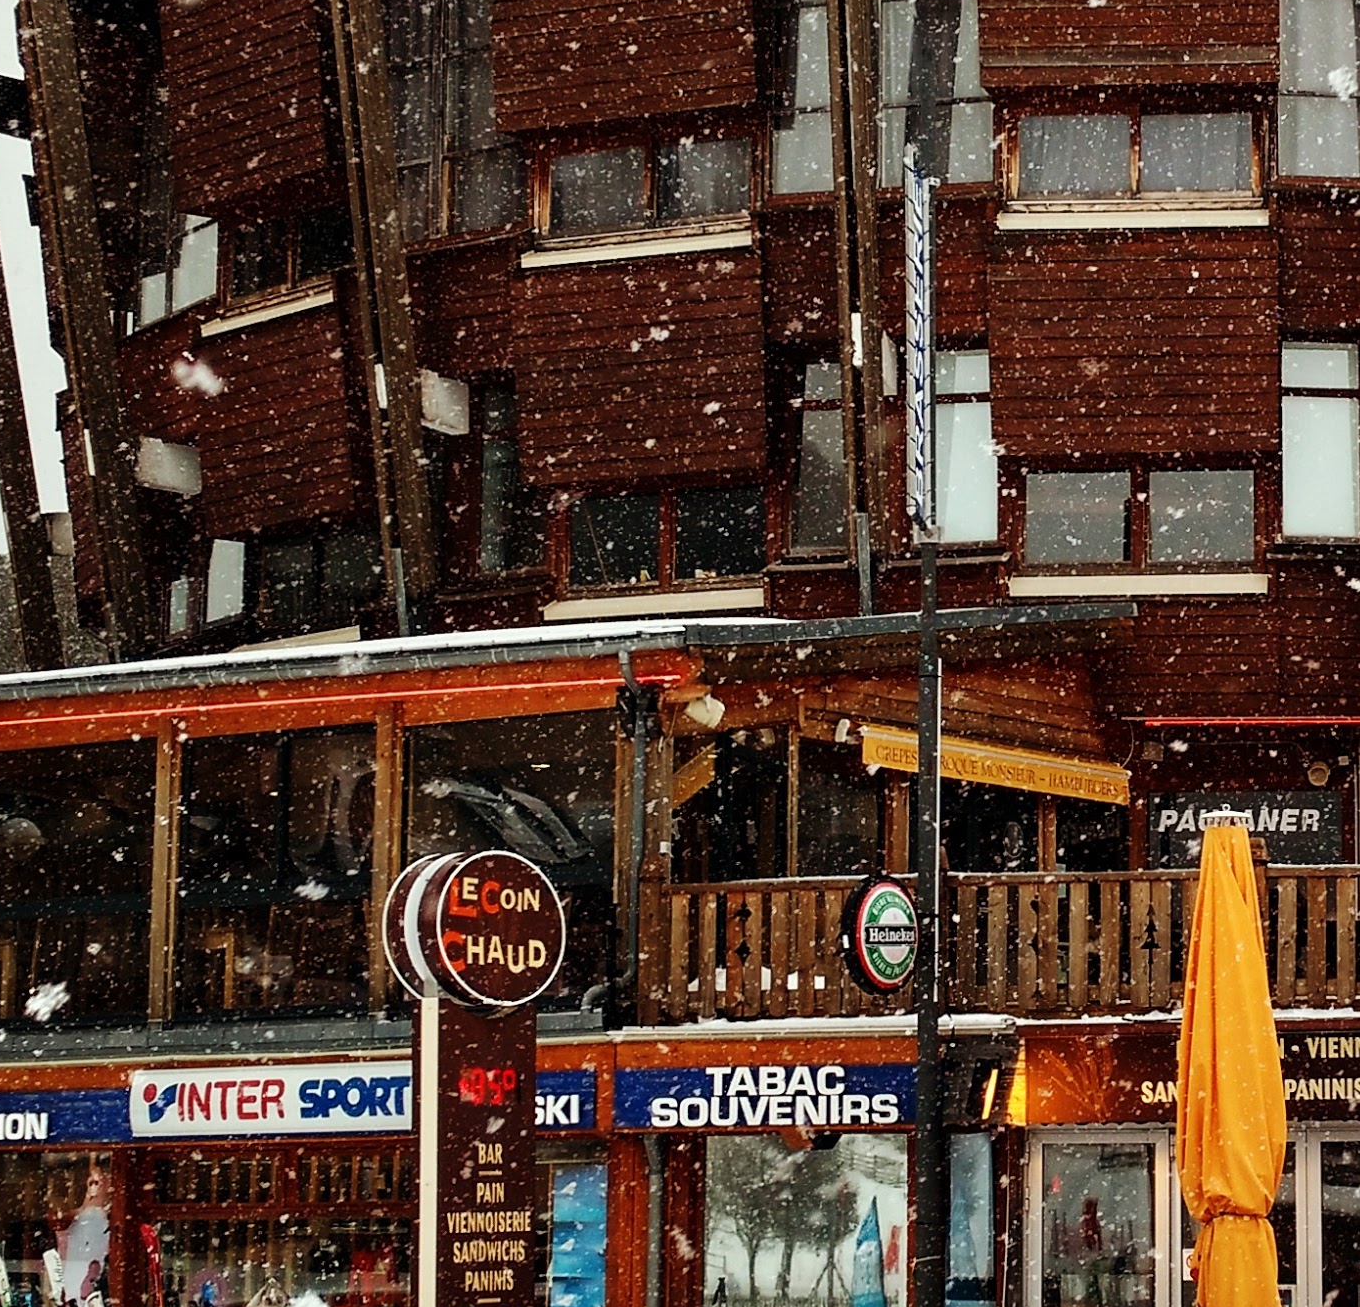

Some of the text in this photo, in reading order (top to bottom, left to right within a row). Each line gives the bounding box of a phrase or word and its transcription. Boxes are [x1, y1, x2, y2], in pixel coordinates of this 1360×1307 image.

[941, 755, 977, 775] ROQUE
[869, 927, 915, 942] Heineken
[439, 930, 547, 974] CHAUD
[705, 1066, 846, 1097] TABAC
[177, 1074, 580, 1126] INTER SPORT SKI
[650, 1093, 900, 1128] SOUVENIRS
[478, 1143, 503, 1165] BAR
[476, 1182, 505, 1204] PAIN
[447, 1210, 532, 1234] VIENNOISERIE
[453, 1239, 526, 1264] SANDWICHS
[464, 1269, 515, 1292] PANINIS
